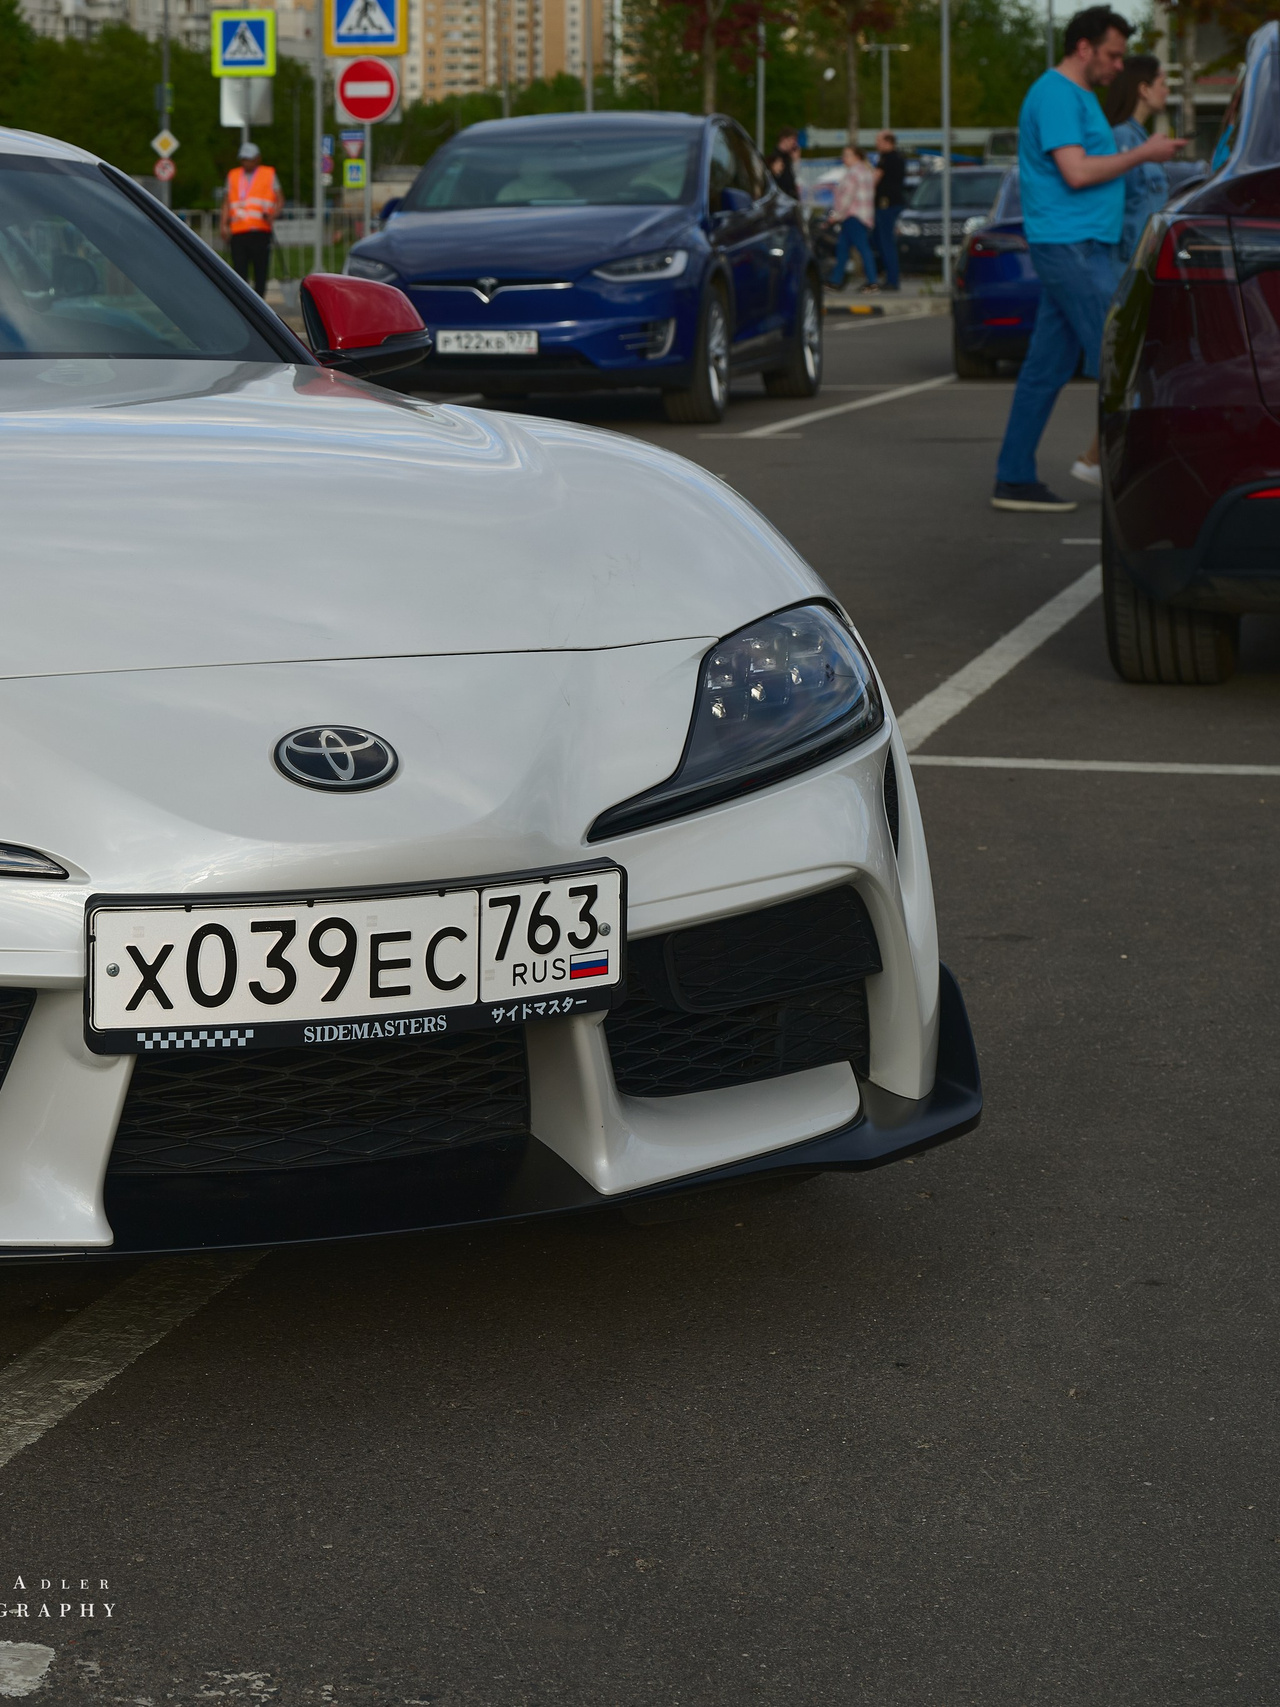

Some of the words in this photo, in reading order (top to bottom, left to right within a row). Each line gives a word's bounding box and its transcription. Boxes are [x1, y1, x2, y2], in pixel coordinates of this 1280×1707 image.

[488, 884, 598, 961] 763
[512, 957, 567, 987] RUS
[491, 996, 588, 1024] サイドマスター
[303, 1014, 448, 1044] SIDEMASTERS
